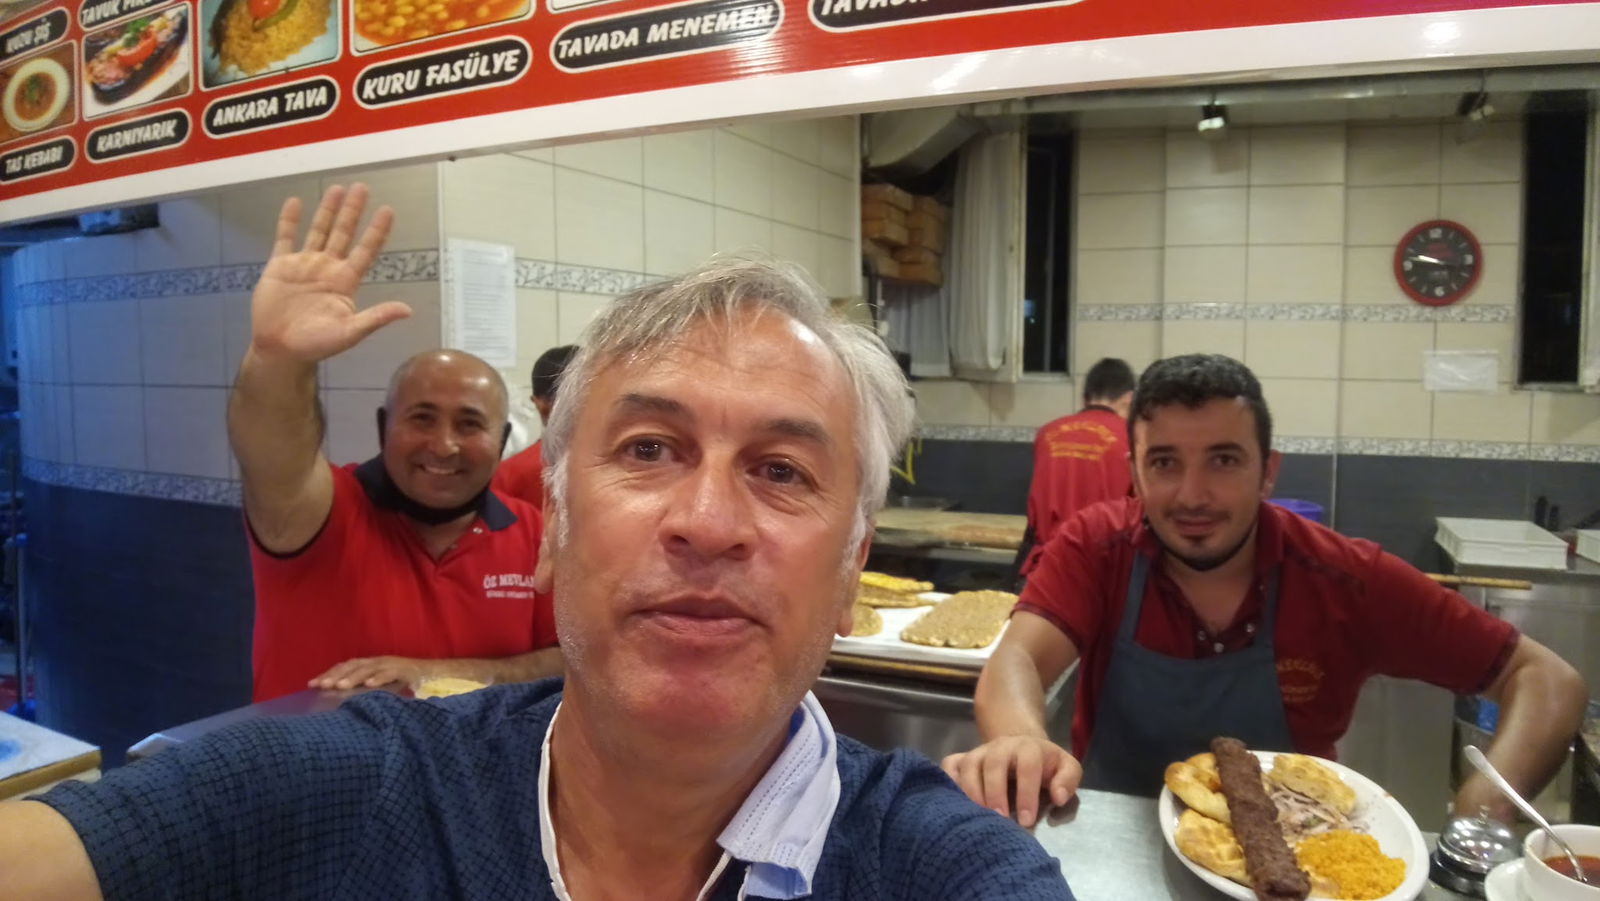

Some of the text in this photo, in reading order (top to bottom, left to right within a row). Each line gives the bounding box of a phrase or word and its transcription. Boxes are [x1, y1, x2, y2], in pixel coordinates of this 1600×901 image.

[558, 5, 774, 59] TAVADA MENEMEN
[362, 49, 521, 99] KURU FASÜLYE
[212, 86, 327, 127] ANKARA TAVA
[96, 119, 177, 153] KARNIYARIK
